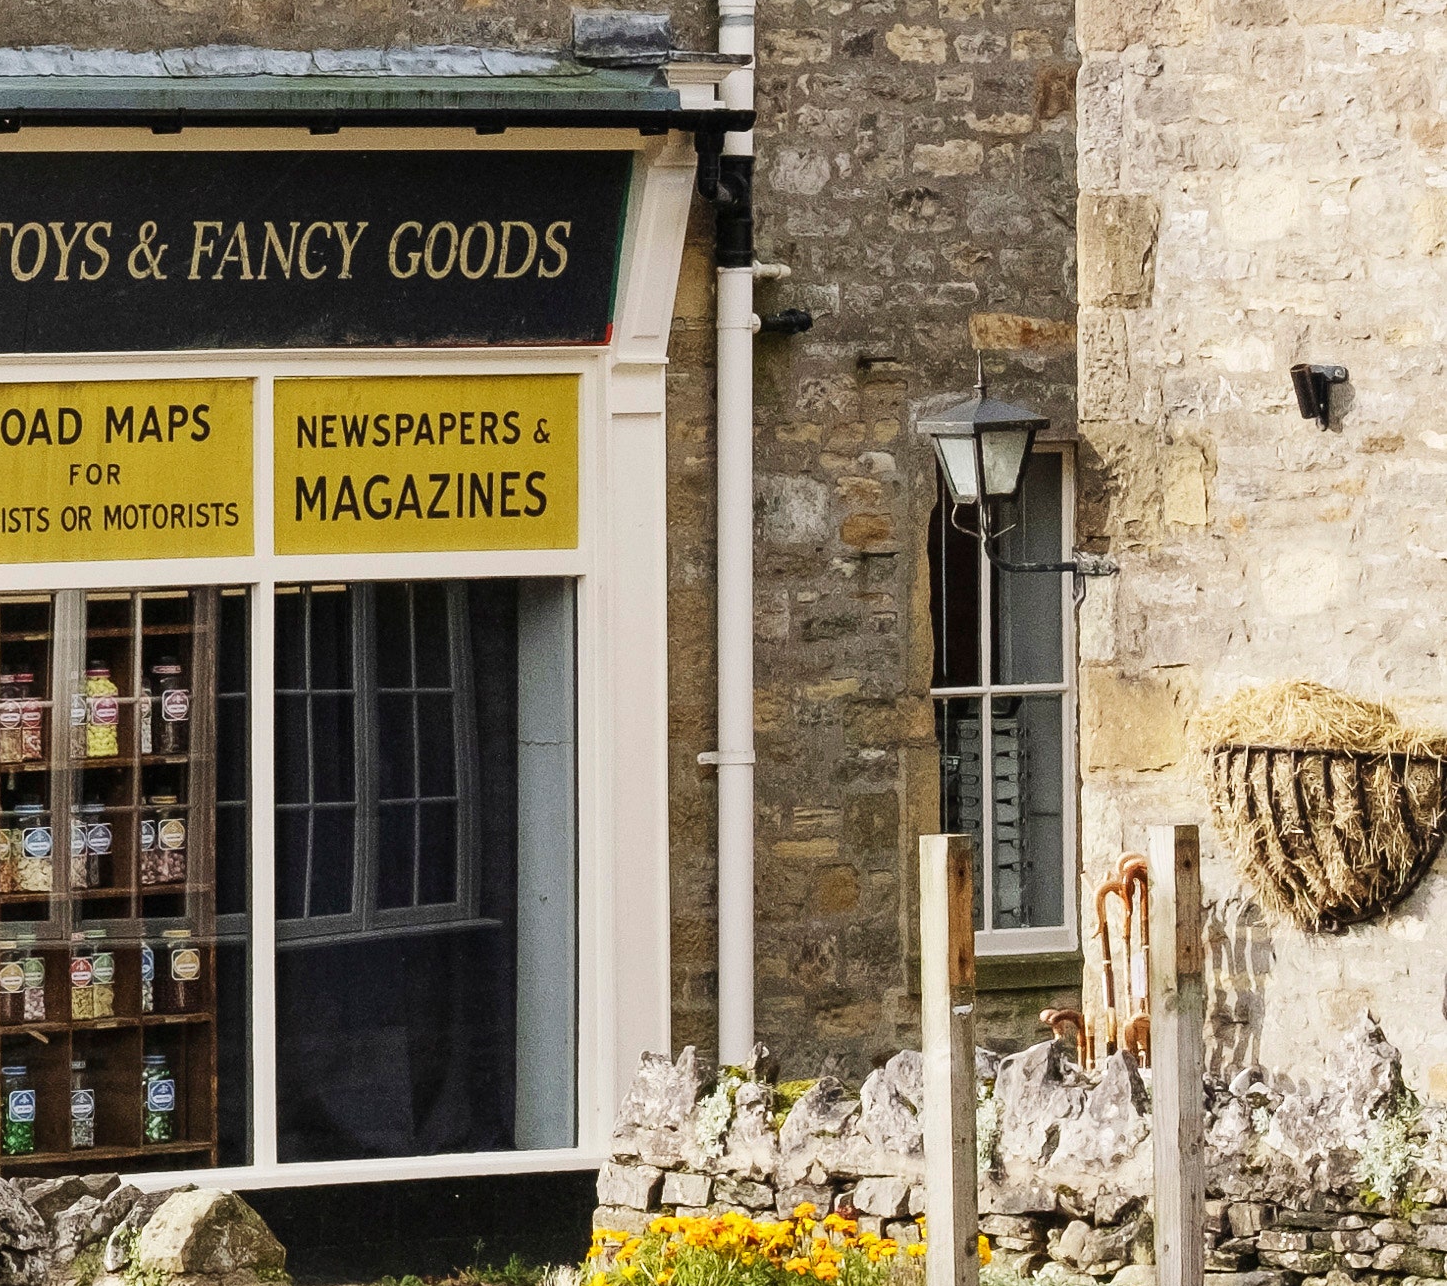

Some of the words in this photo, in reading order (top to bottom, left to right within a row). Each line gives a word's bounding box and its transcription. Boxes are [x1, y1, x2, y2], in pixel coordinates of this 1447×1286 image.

[127, 220, 167, 280] &
[187, 221, 369, 280] FANCY
[388, 221, 572, 280] GOODS
[104, 403, 211, 444] MAPS
[296, 410, 522, 449] NEWSPAPERS
[532, 417, 551, 444] &
[68, 463, 121, 486] FOR
[294, 470, 548, 522] MAGAZINES
[60, 505, 92, 532] OR
[103, 502, 240, 531] MOTORISTS
